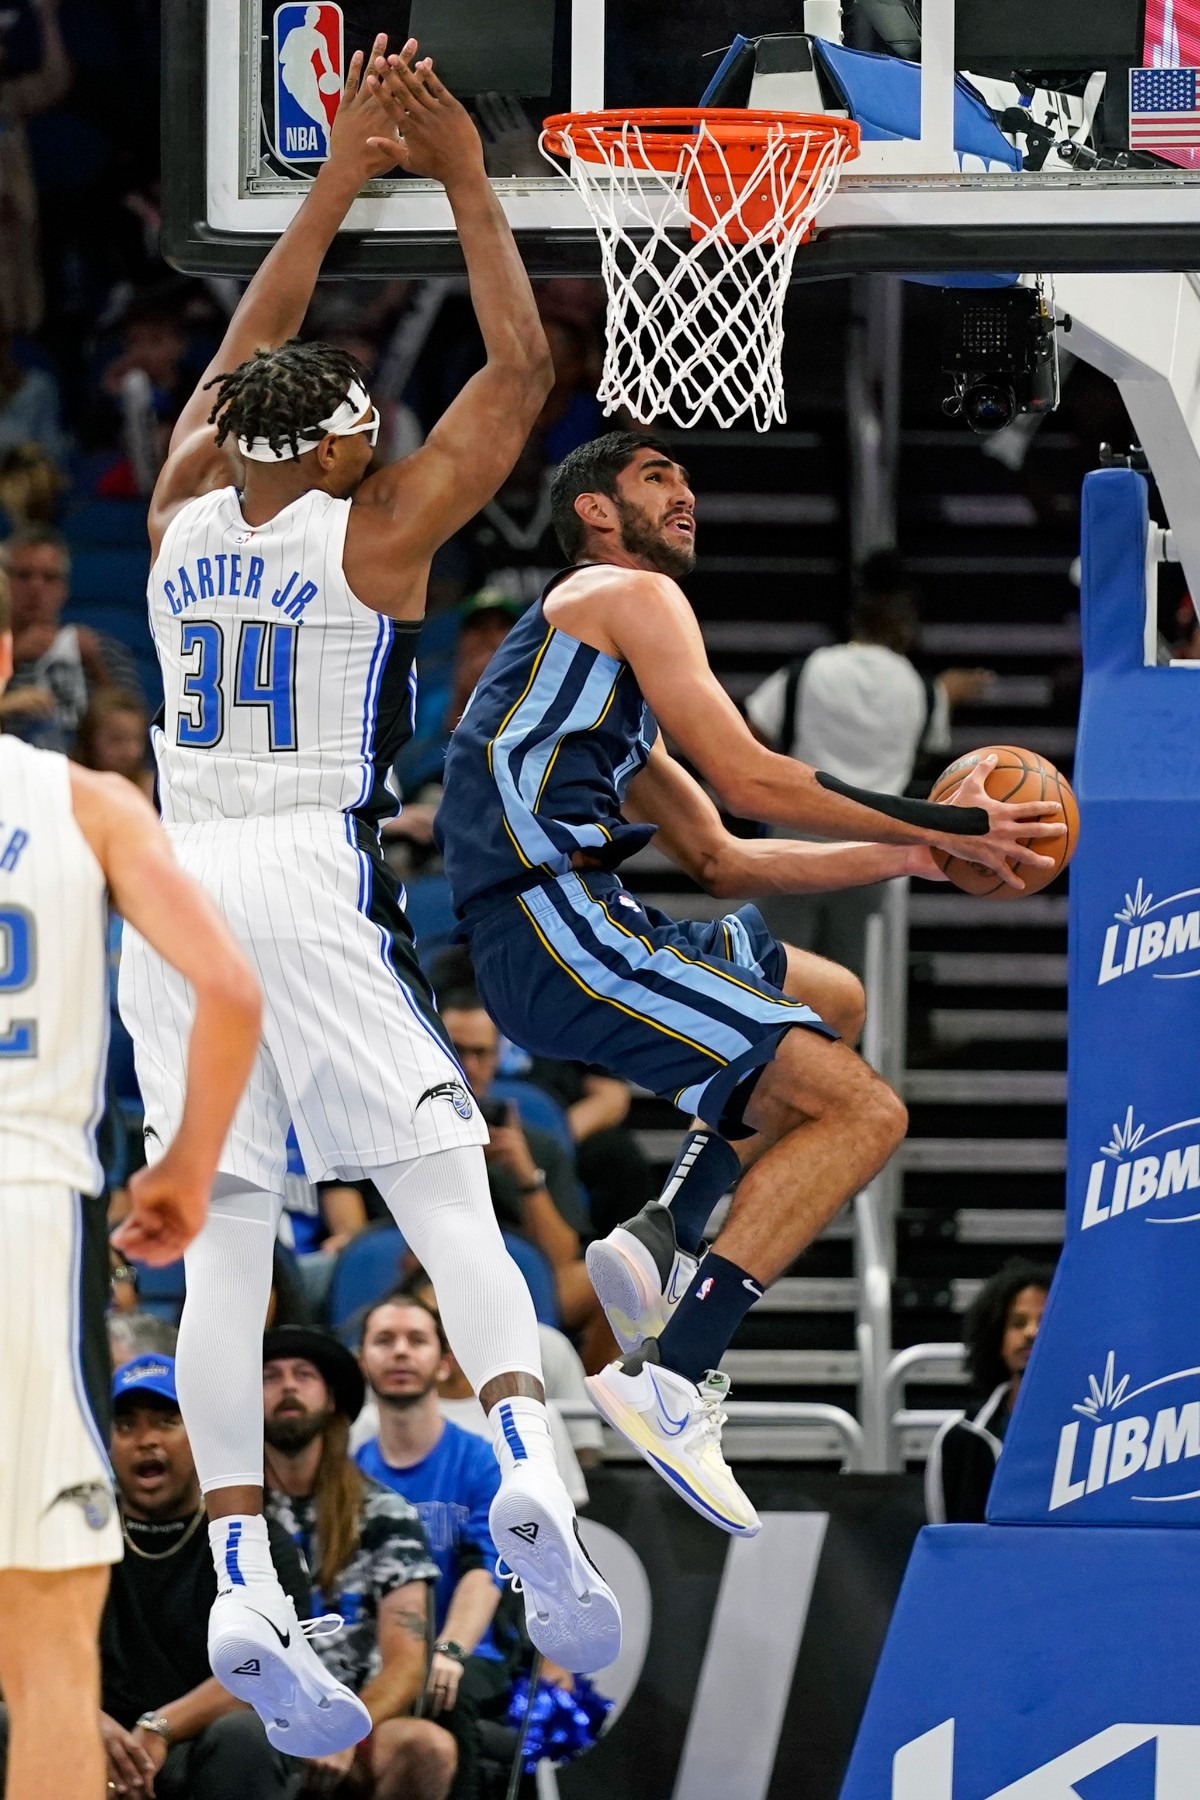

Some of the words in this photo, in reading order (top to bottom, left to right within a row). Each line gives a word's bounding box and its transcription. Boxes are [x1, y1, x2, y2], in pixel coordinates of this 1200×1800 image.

[286, 126, 319, 152] NBA
[163, 553, 265, 616] CARTER
[176, 619, 300, 753] 34
